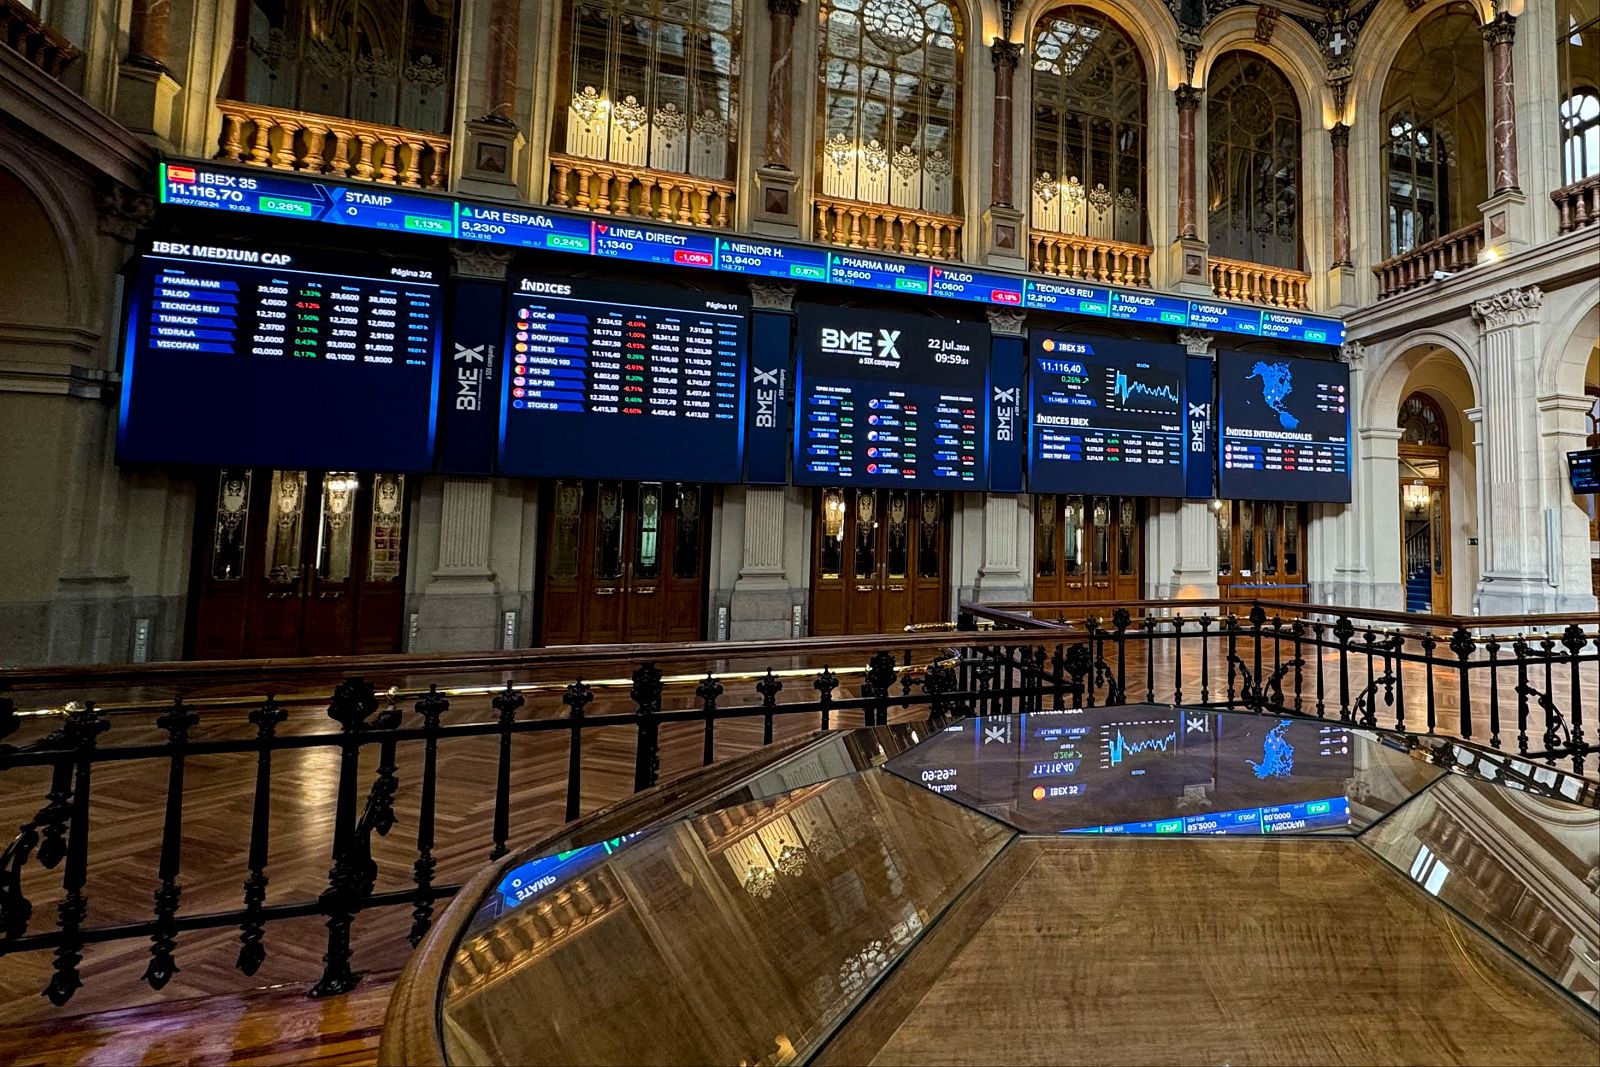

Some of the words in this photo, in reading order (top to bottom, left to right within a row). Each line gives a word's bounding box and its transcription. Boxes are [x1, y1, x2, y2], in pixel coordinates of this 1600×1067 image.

[200, 172, 236, 187] IBEX
[239, 178, 257, 189] 35
[168, 182, 243, 202] 11.116,70
[346, 192, 392, 206] STAMP
[268, 201, 304, 212] 0,26%
[474, 209, 500, 220] LAR
[502, 212, 554, 228] ESPAÑA
[414, 220, 443, 230] 1,13%
[462, 222, 506, 234] 8,2300
[554, 238, 584, 248] 0,24%
[610, 228, 644, 240] LINEA
[646, 232, 688, 246] DIRECT
[598, 240, 634, 250] 1,1340
[732, 243, 772, 256] NEINOR
[774, 248, 784, 258] H.
[152, 241, 190, 256] IBEX
[192, 245, 258, 262] MEDIUM
[260, 252, 291, 265] CAP
[680, 254, 708, 264] -1,05%
[720, 254, 761, 266] 13,9400
[842, 258, 882, 270] PHARMA
[884, 264, 906, 274] MAR
[391, 268, 418, 278] Página
[796, 268, 820, 276] 0,87%
[832, 268, 871, 280] 39,5600
[944, 272, 972, 282] TALGO
[162, 276, 200, 286] PHARMA
[200, 280, 220, 288] MAR
[258, 286, 288, 294] 39,5600
[520, 278, 572, 295] ÍNDICES
[901, 281, 922, 289] 1,33%
[934, 282, 964, 292] 4,0600
[1036, 284, 1076, 296] TECNICAS
[1076, 289, 1094, 298] REU
[162, 289, 190, 298] TALGO
[295, 302, 320, 310] -0,12%
[334, 305, 359, 314] 4,1000
[1026, 294, 1056, 303] 12,2100
[1120, 295, 1155, 306] TUBACEX
[160, 302, 202, 312] TECNICAS
[706, 302, 728, 310] Página
[1112, 304, 1137, 312] 2,9700
[1198, 305, 1228, 316] VIDRALA
[1190, 314, 1218, 323] 92,2000
[1270, 314, 1302, 326] VISCOFAN
[159, 315, 198, 324] TUBACEX
[259, 323, 285, 332] 2,9700
[332, 329, 357, 338] 2,9700
[1262, 324, 1288, 332] 60,0000
[158, 328, 196, 336] VIDRALA
[294, 338, 318, 346] 0,43%
[822, 328, 872, 351] BME
[157, 341, 200, 350] VISCOFAN
[928, 339, 940, 348] 22
[1058, 343, 1076, 352] IBEX
[1076, 345, 1086, 353] 35
[530, 356, 558, 365] NASDAQ
[864, 358, 874, 366] SIX
[874, 359, 900, 368] company
[1042, 362, 1081, 374] 11.116,40
[1061, 376, 1080, 384] 0,26%
[456, 367, 478, 410] BME
[756, 388, 773, 428] BME
[997, 406, 1010, 441] BME
[1036, 413, 1070, 425] ÍNDICES
[1070, 416, 1089, 426] IBEX
[1192, 420, 1202, 452] BME
[1226, 426, 1252, 438] ÍNDICES
[1254, 430, 1312, 441] INTERNACIONALES
